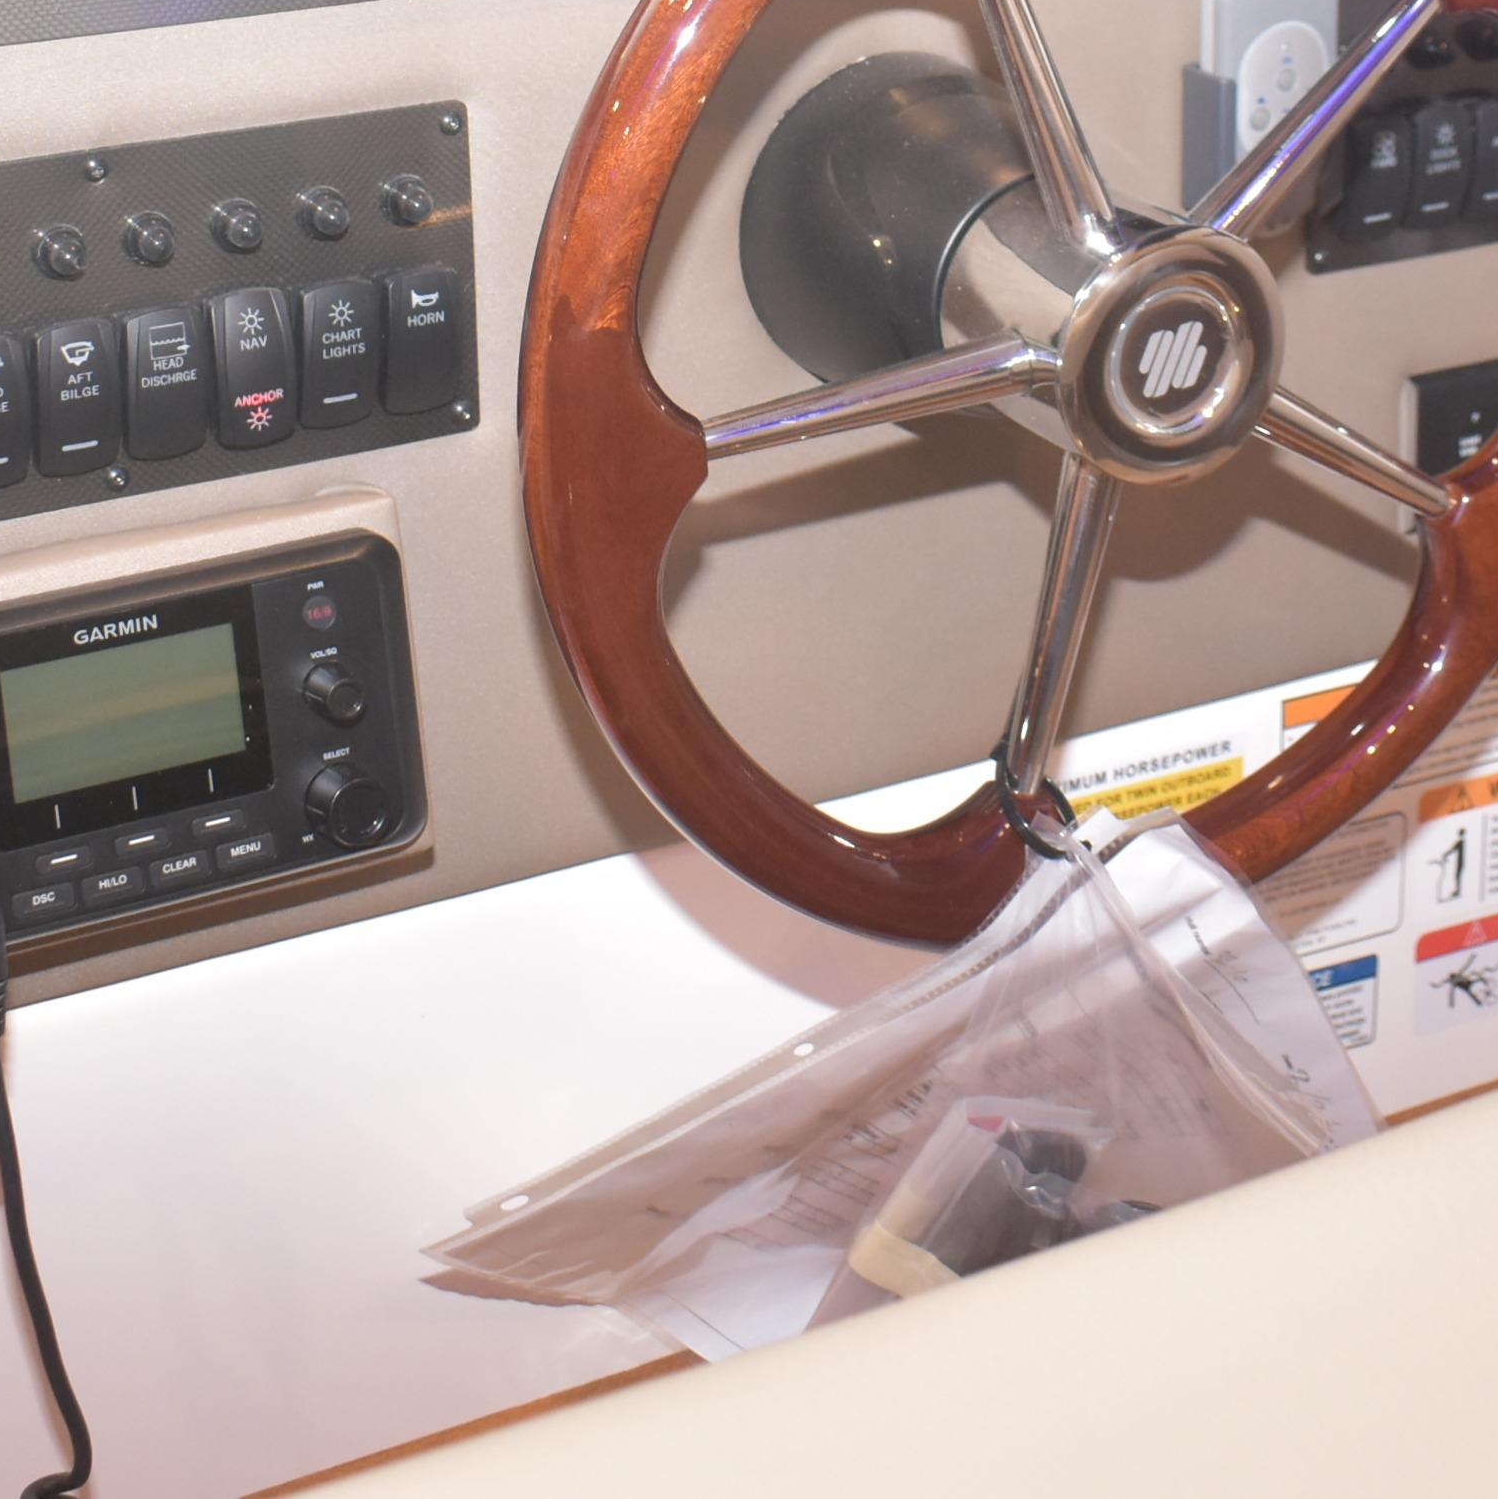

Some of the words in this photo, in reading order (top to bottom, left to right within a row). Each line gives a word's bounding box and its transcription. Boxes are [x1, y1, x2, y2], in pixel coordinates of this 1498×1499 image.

[407, 310, 445, 328] HORN
[239, 335, 268, 351] NAV
[322, 328, 363, 345] CHART
[322, 342, 366, 360] LIGHTS
[153, 356, 184, 371] HEAD
[67, 371, 93, 386] AFT
[141, 369, 198, 388] DISCHRGE
[60, 384, 101, 402] BILGE
[234, 388, 284, 408] ANCHOR
[73, 614, 158, 645] GARMIN
[322, 747, 351, 761] SELECT
[1059, 770, 1108, 794] IMUM
[1112, 739, 1232, 781] HORSEPOWER
[1159, 766, 1232, 793] OUTBOARD
[230, 840, 262, 858] MENU
[162, 857, 197, 875] CLEAR
[98, 874, 128, 890] HI/LO
[32, 891, 56, 906] DSC
